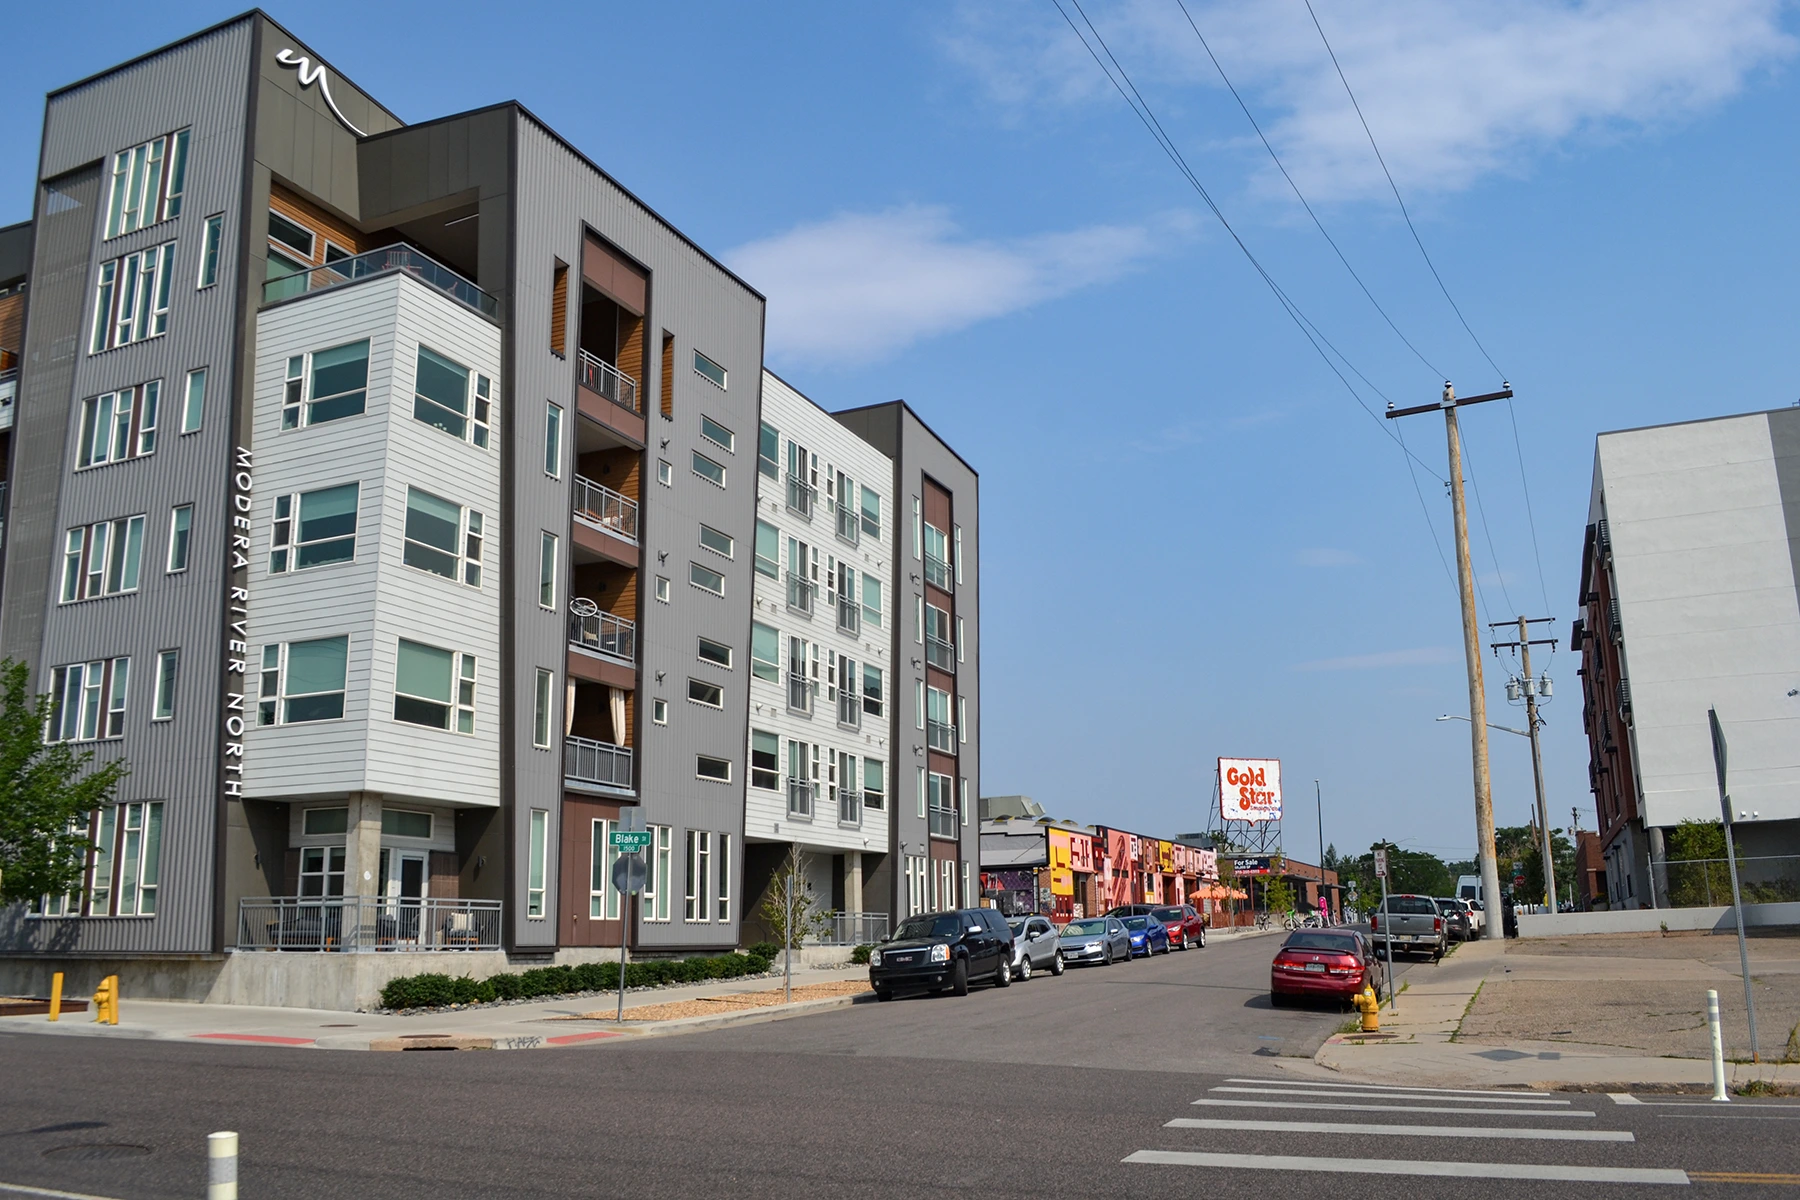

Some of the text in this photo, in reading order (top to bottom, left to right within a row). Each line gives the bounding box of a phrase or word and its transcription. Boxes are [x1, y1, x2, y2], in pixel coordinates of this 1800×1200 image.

[225, 446, 253, 796] MODERA RIVER NORTH
[1226, 766, 1267, 787] Gold
[1239, 786, 1275, 811] Star
[615, 834, 639, 844] Blake
